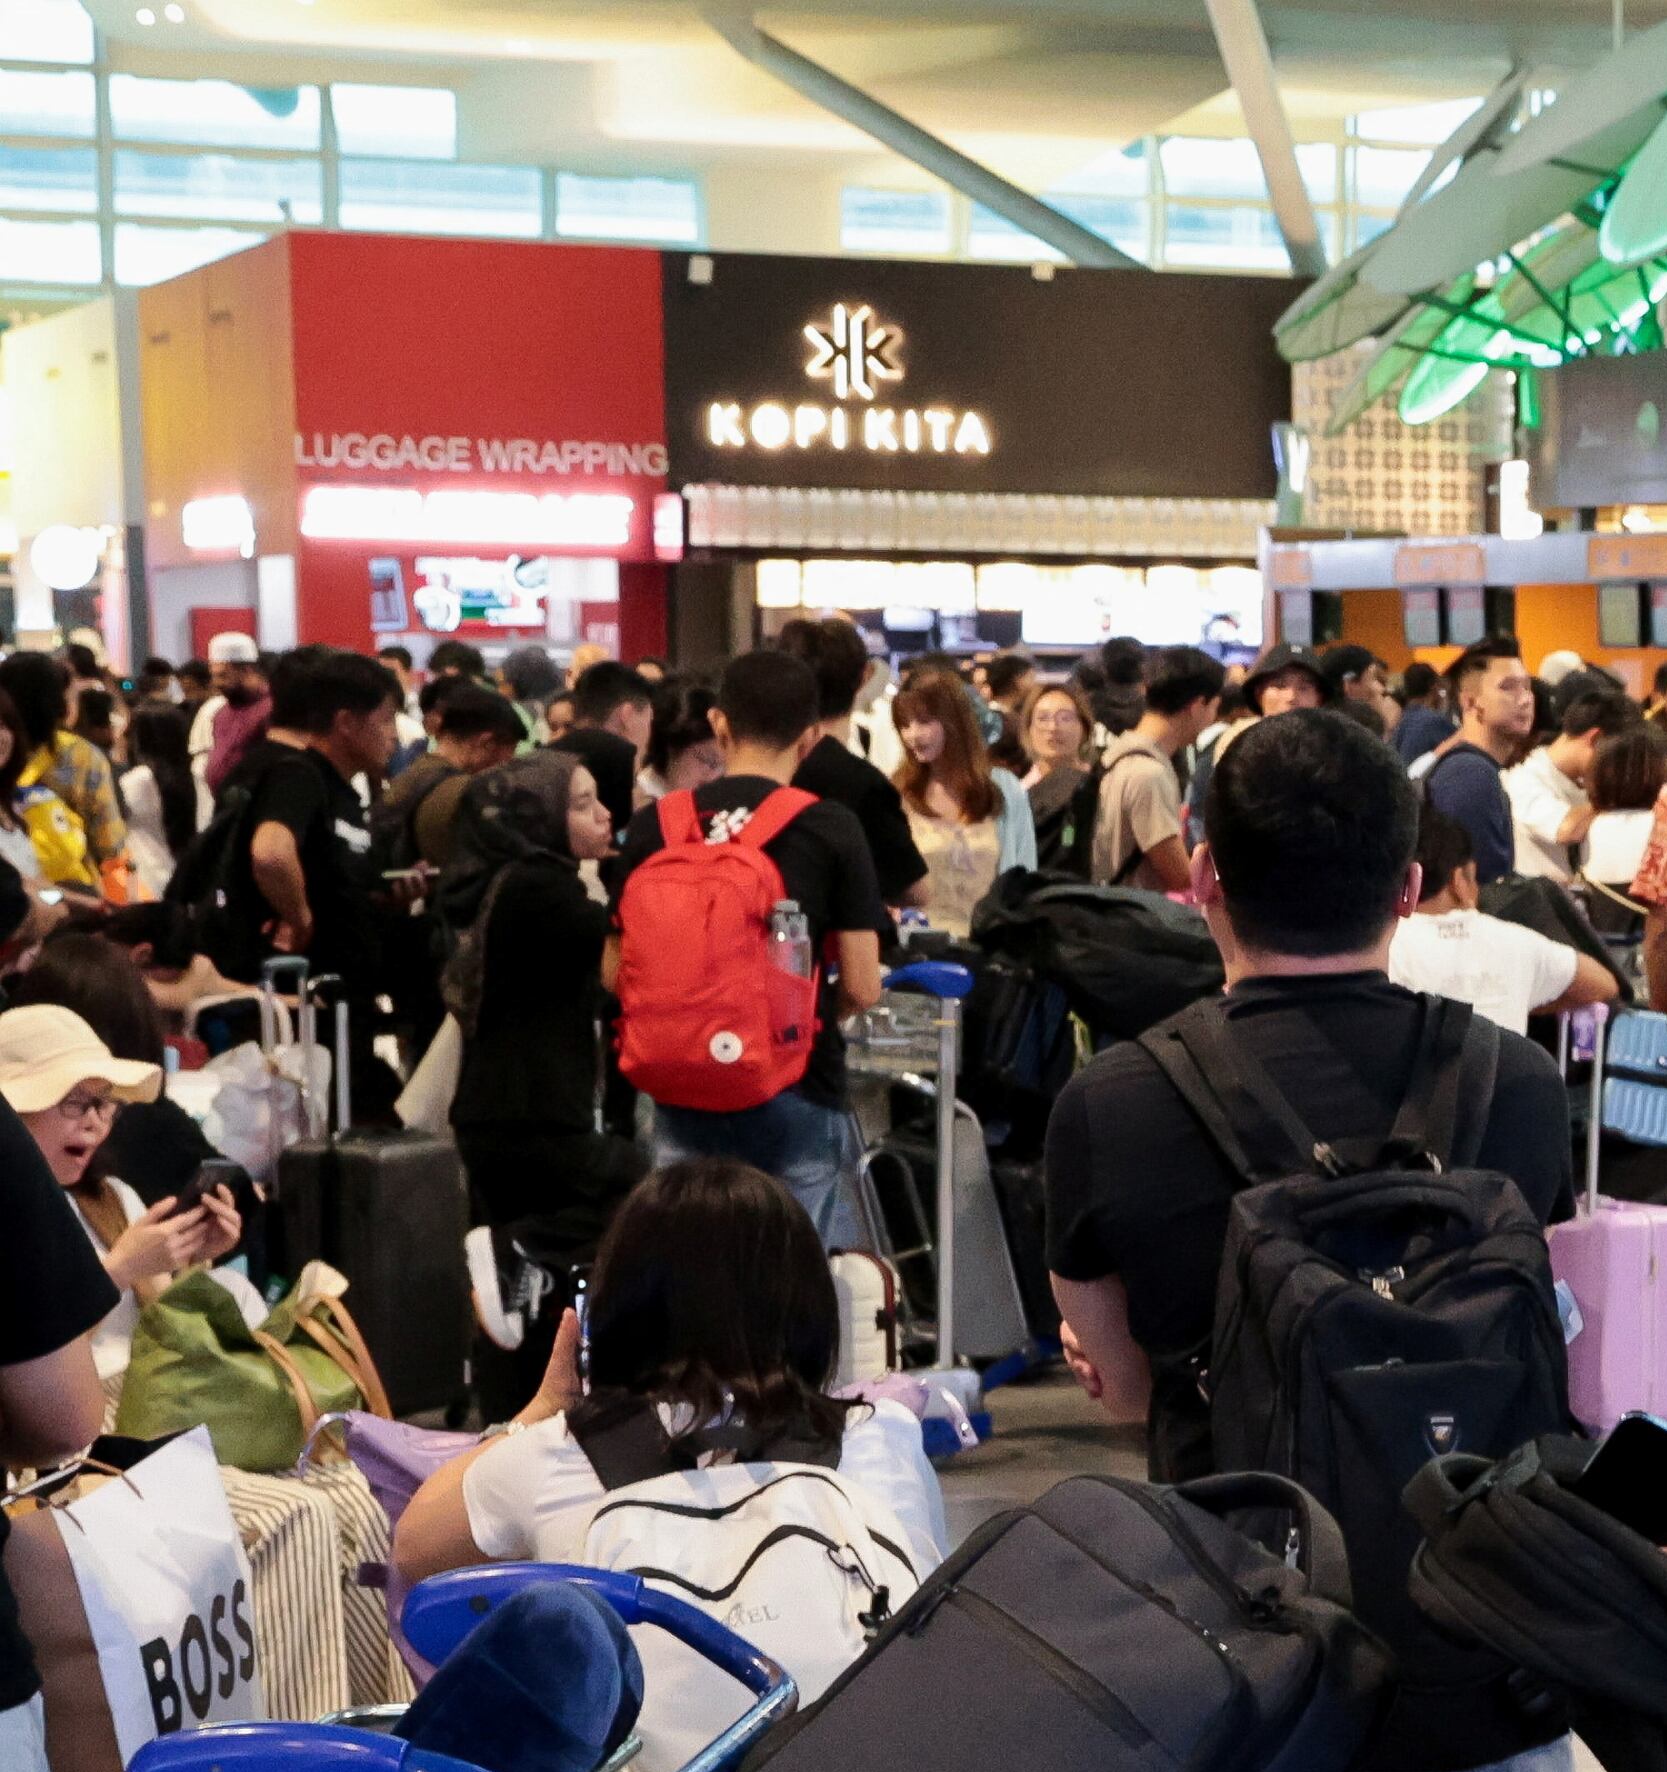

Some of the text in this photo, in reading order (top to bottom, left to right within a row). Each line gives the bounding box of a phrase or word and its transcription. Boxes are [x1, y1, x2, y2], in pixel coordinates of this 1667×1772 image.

[708, 402, 990, 455] KOPI KITA
[294, 433, 669, 478] LUGGAGE WRAPPING
[139, 1578, 255, 1738] BOSS
